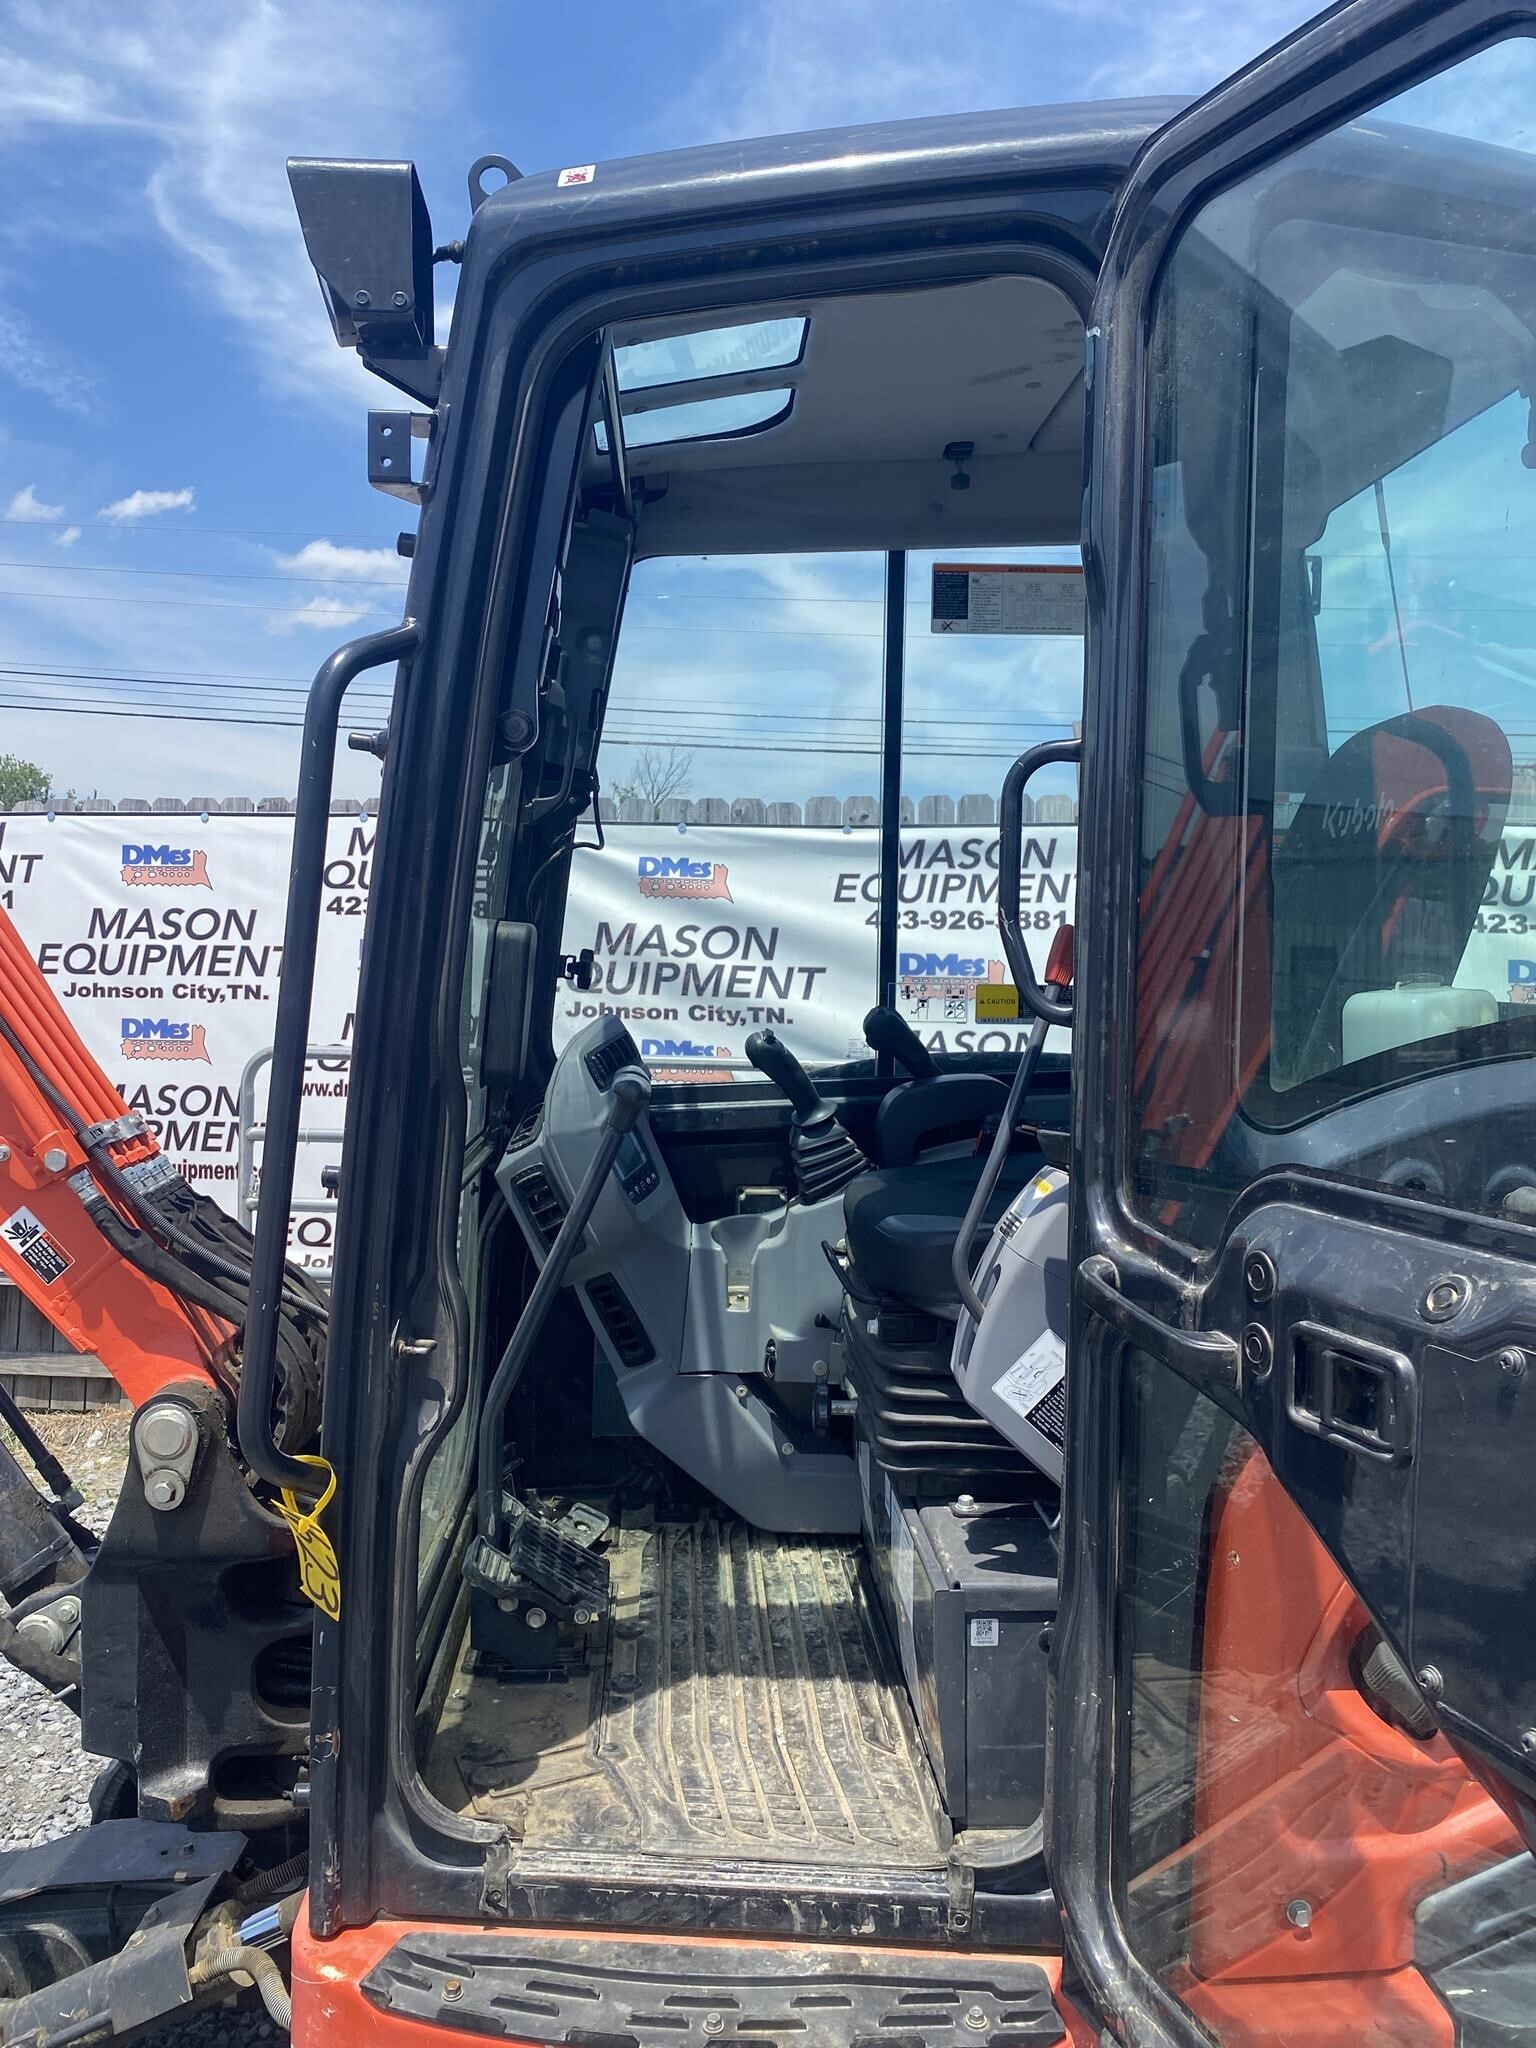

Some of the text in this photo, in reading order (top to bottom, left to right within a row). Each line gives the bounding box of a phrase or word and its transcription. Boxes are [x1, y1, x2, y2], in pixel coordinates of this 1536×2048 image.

[1322, 792, 1396, 838] Kubota
[87, 908, 257, 941] MASON
[594, 921, 779, 961] MASON
[63, 982, 269, 1003] Johnson City,TN.
[556, 960, 827, 1000] QUIPMENT
[688, 1005, 794, 1026] City,TN.
